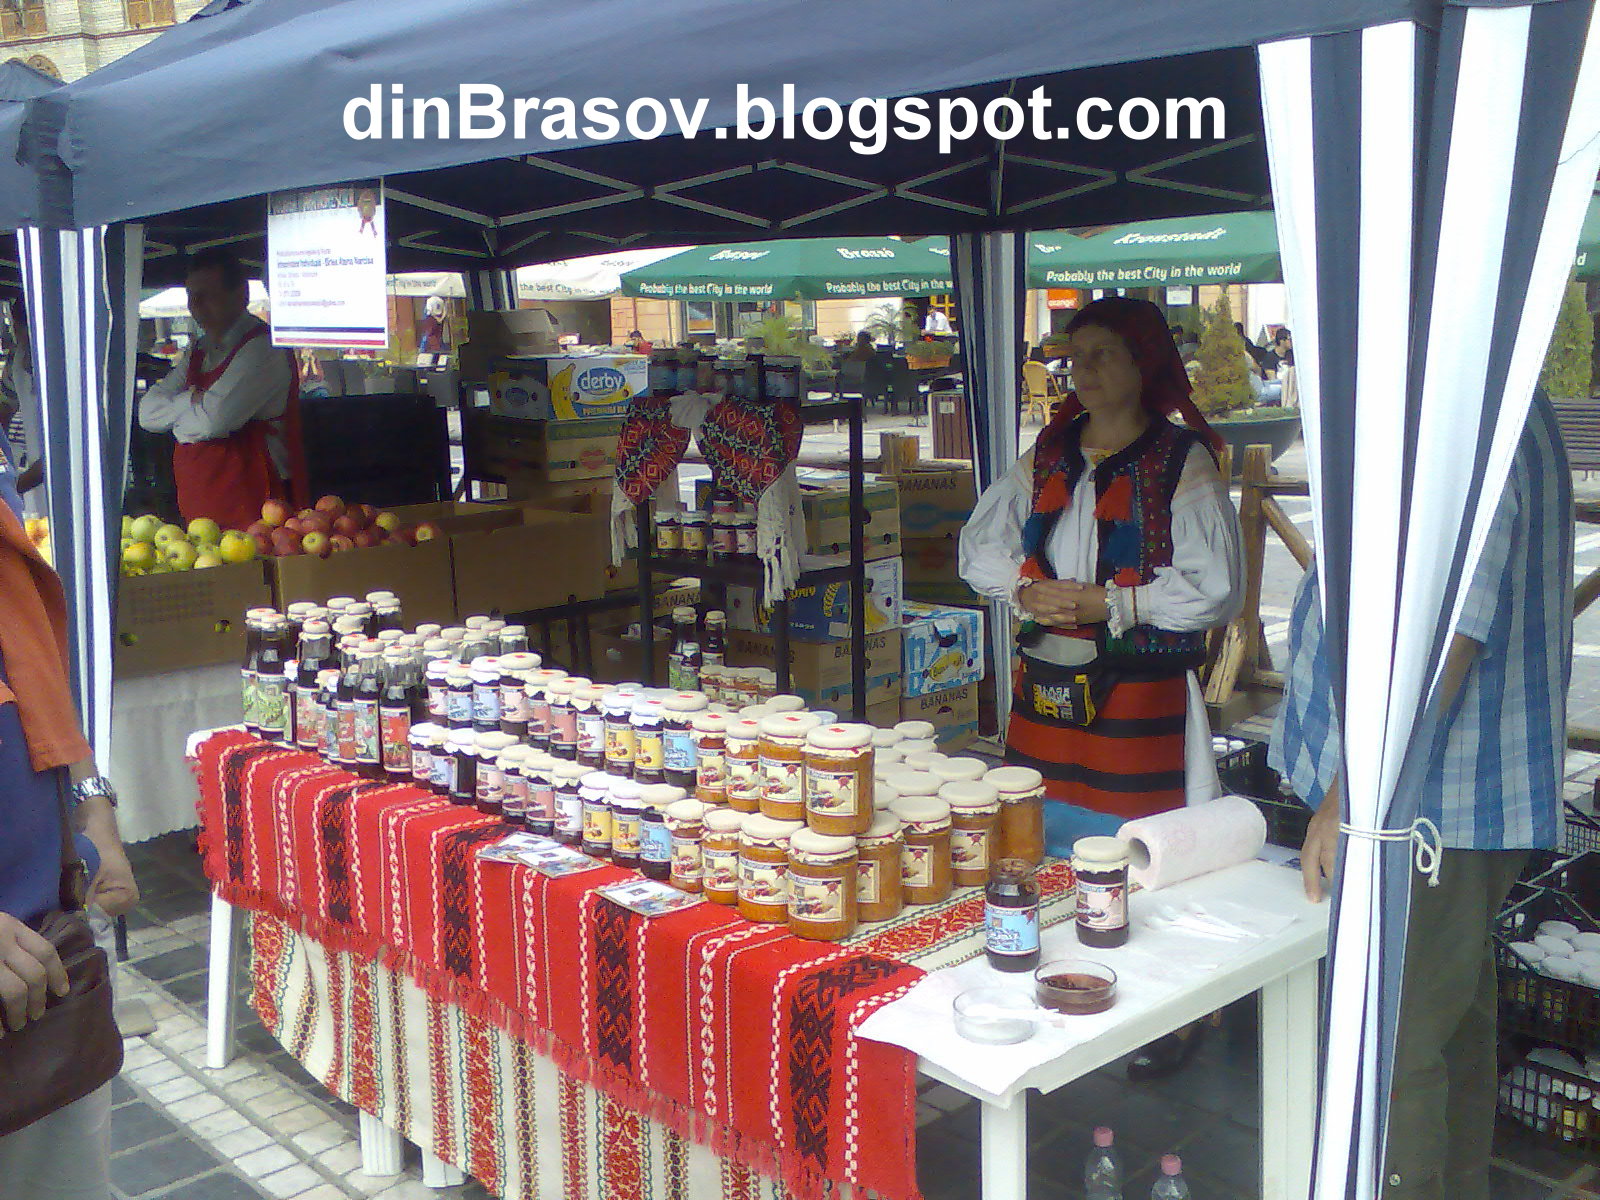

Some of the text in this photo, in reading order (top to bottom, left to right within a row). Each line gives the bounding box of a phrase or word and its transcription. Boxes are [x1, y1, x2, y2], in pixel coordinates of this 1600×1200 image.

[1046, 262, 1242, 284] Probably the best City in the world
[640, 282, 773, 297] Probably the best City in the world
[826, 281, 866, 295] Probably
[866, 281, 880, 292] the
[883, 280, 900, 292] best
[901, 279, 919, 293] City
[930, 279, 944, 289] the
[580, 368, 623, 391] derby
[920, 689, 968, 710] BANANAS
